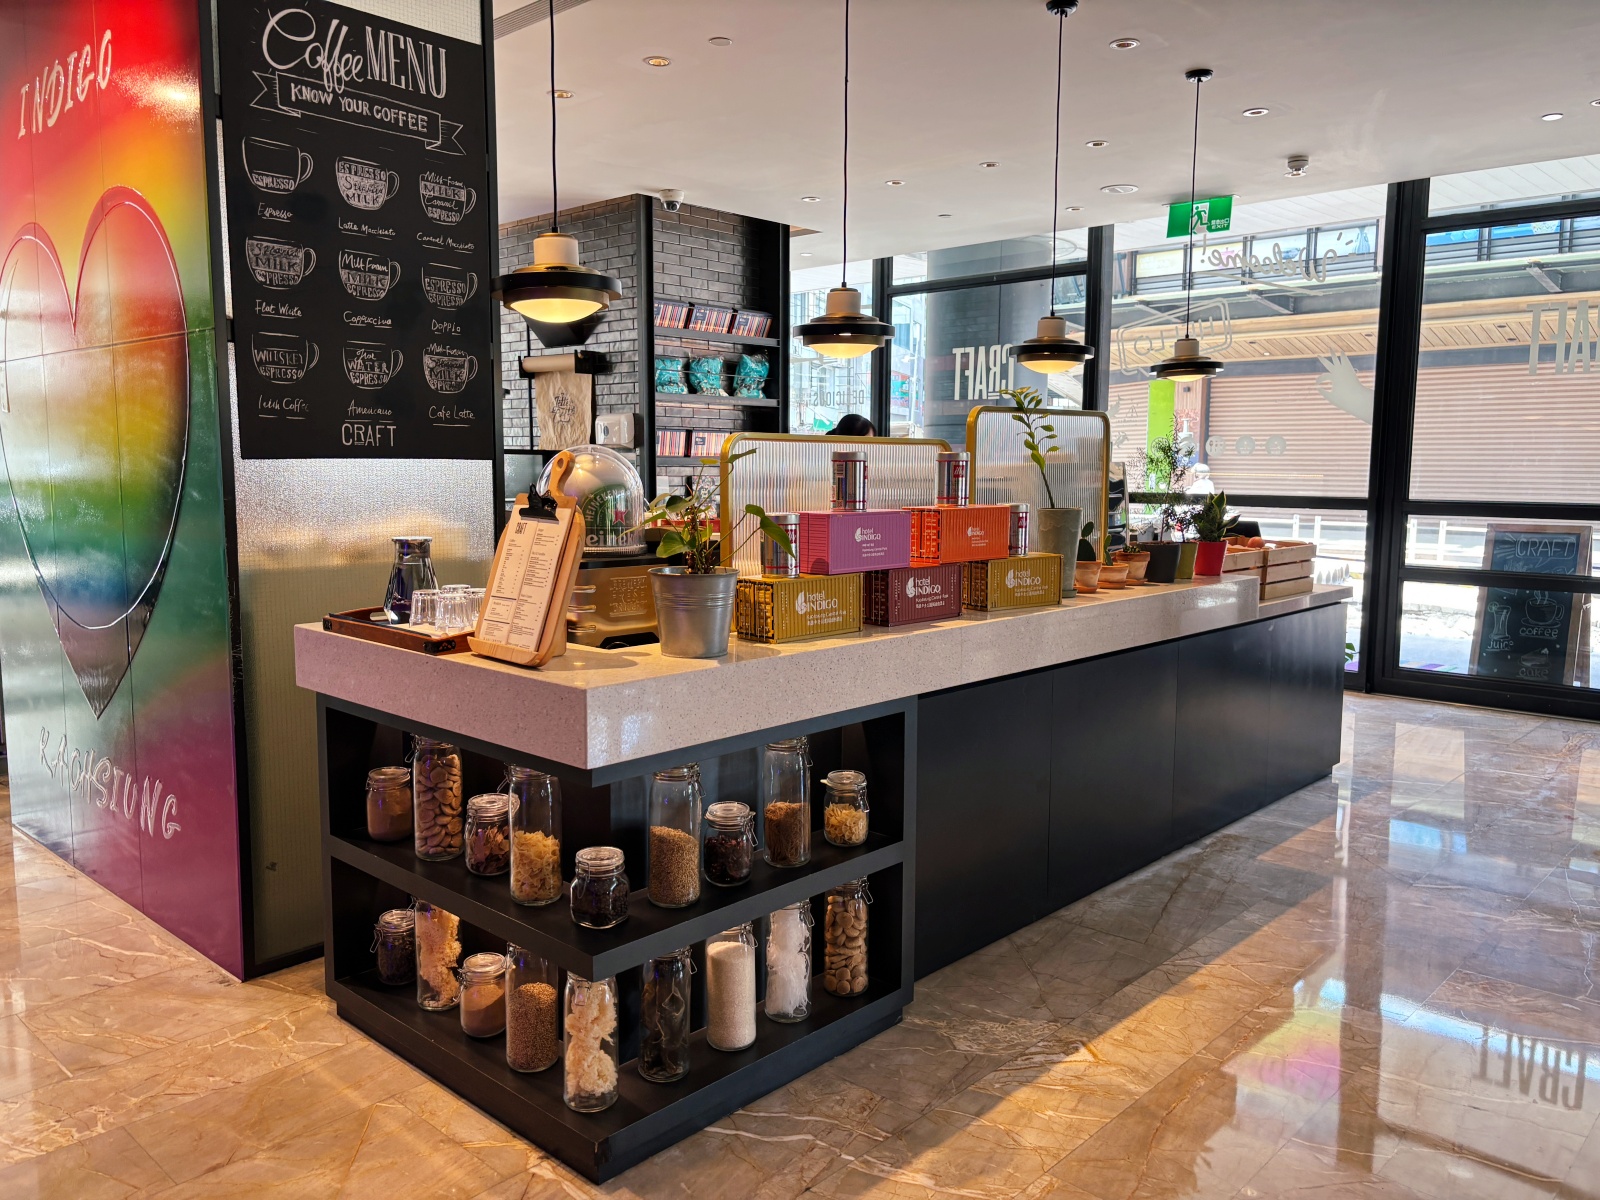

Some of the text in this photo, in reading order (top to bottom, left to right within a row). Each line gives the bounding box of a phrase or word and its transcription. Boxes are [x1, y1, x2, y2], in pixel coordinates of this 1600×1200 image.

[262, 8, 447, 98] Coffee MENU
[18, 29, 112, 139] INDIGO
[291, 82, 428, 133] KNOW YOUR COFFEE
[338, 160, 387, 181] ESPRESSO
[252, 173, 295, 191] ESPRESSO
[346, 192, 380, 206] MILK
[423, 183, 461, 199] MILK
[258, 202, 293, 219] Espresso
[338, 216, 359, 231] Latte
[255, 256, 300, 273] MILK
[424, 277, 467, 295] ESPRESSO
[255, 299, 277, 315] Flat
[431, 319, 461, 333] Doppio
[347, 359, 389, 374] WATER
[347, 399, 393, 417] Americano
[453, 404, 476, 420] Latte
[341, 423, 397, 447] CRAFT
[861, 533, 882, 541] INDIGO
[1518, 538, 1572, 557] CRAFT
[915, 575, 931, 587] hotel
[1015, 569, 1031, 578] hotel
[1015, 576, 1042, 587] INDIGO
[807, 590, 826, 602] hotel
[915, 584, 942, 596] INDIGO
[807, 598, 839, 612] INDIGO
[1519, 627, 1559, 638] coffee
[1519, 666, 1550, 678] cake
[39, 726, 182, 840] KAOHSIUNG
